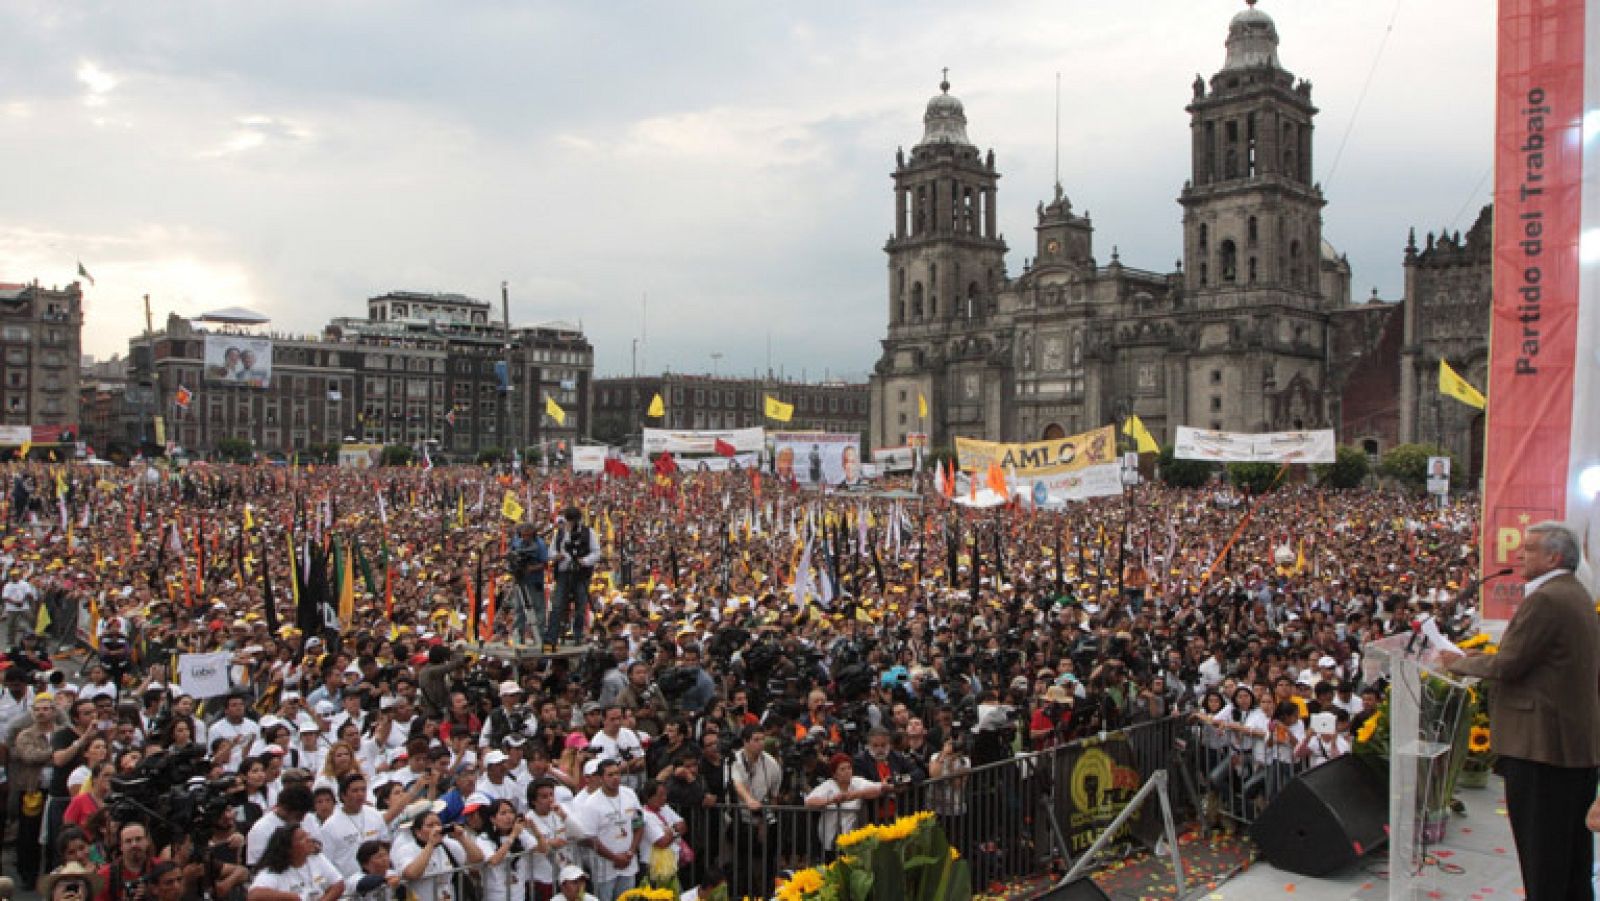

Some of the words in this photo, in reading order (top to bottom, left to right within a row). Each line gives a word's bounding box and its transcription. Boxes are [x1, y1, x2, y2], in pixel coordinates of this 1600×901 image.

[1520, 86, 1550, 201] Trabajo
[1519, 212, 1543, 257] del
[1515, 267, 1542, 376] Partido
[1000, 442, 1076, 468] AMLO
[1496, 527, 1521, 563] P
